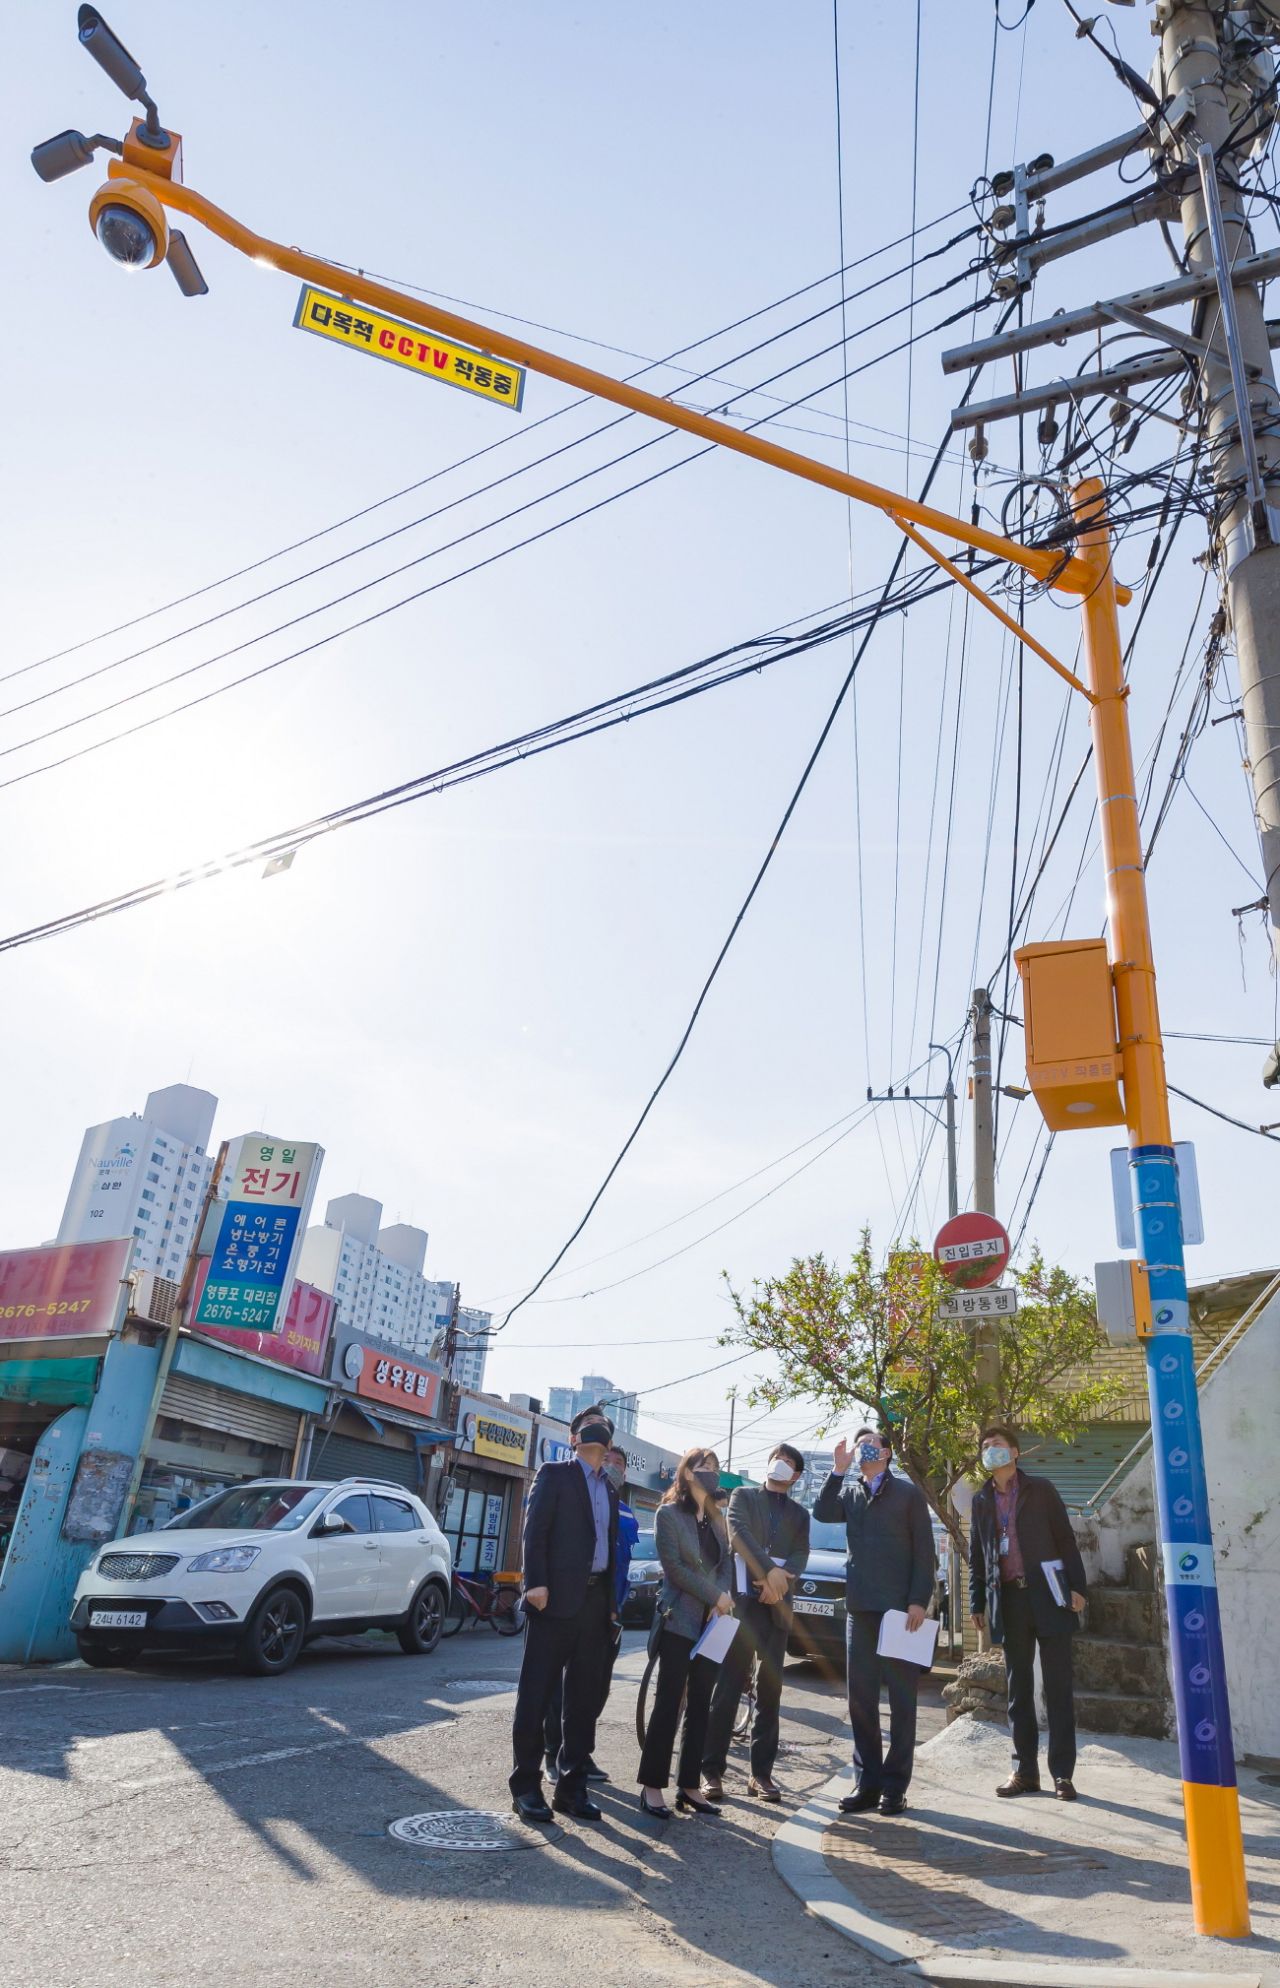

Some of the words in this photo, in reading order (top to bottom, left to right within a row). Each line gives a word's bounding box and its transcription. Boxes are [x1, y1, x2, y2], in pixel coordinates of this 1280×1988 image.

[310, 302, 374, 342] 다목적
[378, 329, 449, 370] CCTV
[454, 357, 512, 395] 작동중
[1031, 1068, 1068, 1082] CCTV
[88, 1156, 133, 1168] Nauville
[260, 1146, 296, 1164] 영일
[241, 1168, 301, 1199] 전기
[90, 1209, 104, 1218] 102
[234, 1214, 287, 1231] 에어콘
[230, 1229, 283, 1245] 냉난방기
[944, 1240, 999, 1262] 진입금지
[222, 1258, 276, 1275] 소형가전
[206, 1285, 240, 1301] 영등포
[243, 1289, 277, 1306] 대리점
[946, 1294, 1009, 1314] 일방통행
[203, 1303, 270, 1324] 2676-5247
[375, 1359, 429, 1398] 성우정밀
[478, 1420, 527, 1451] 두성방전조각
[806, 1603, 830, 1615] 7642
[116, 1613, 142, 1626] 6142
